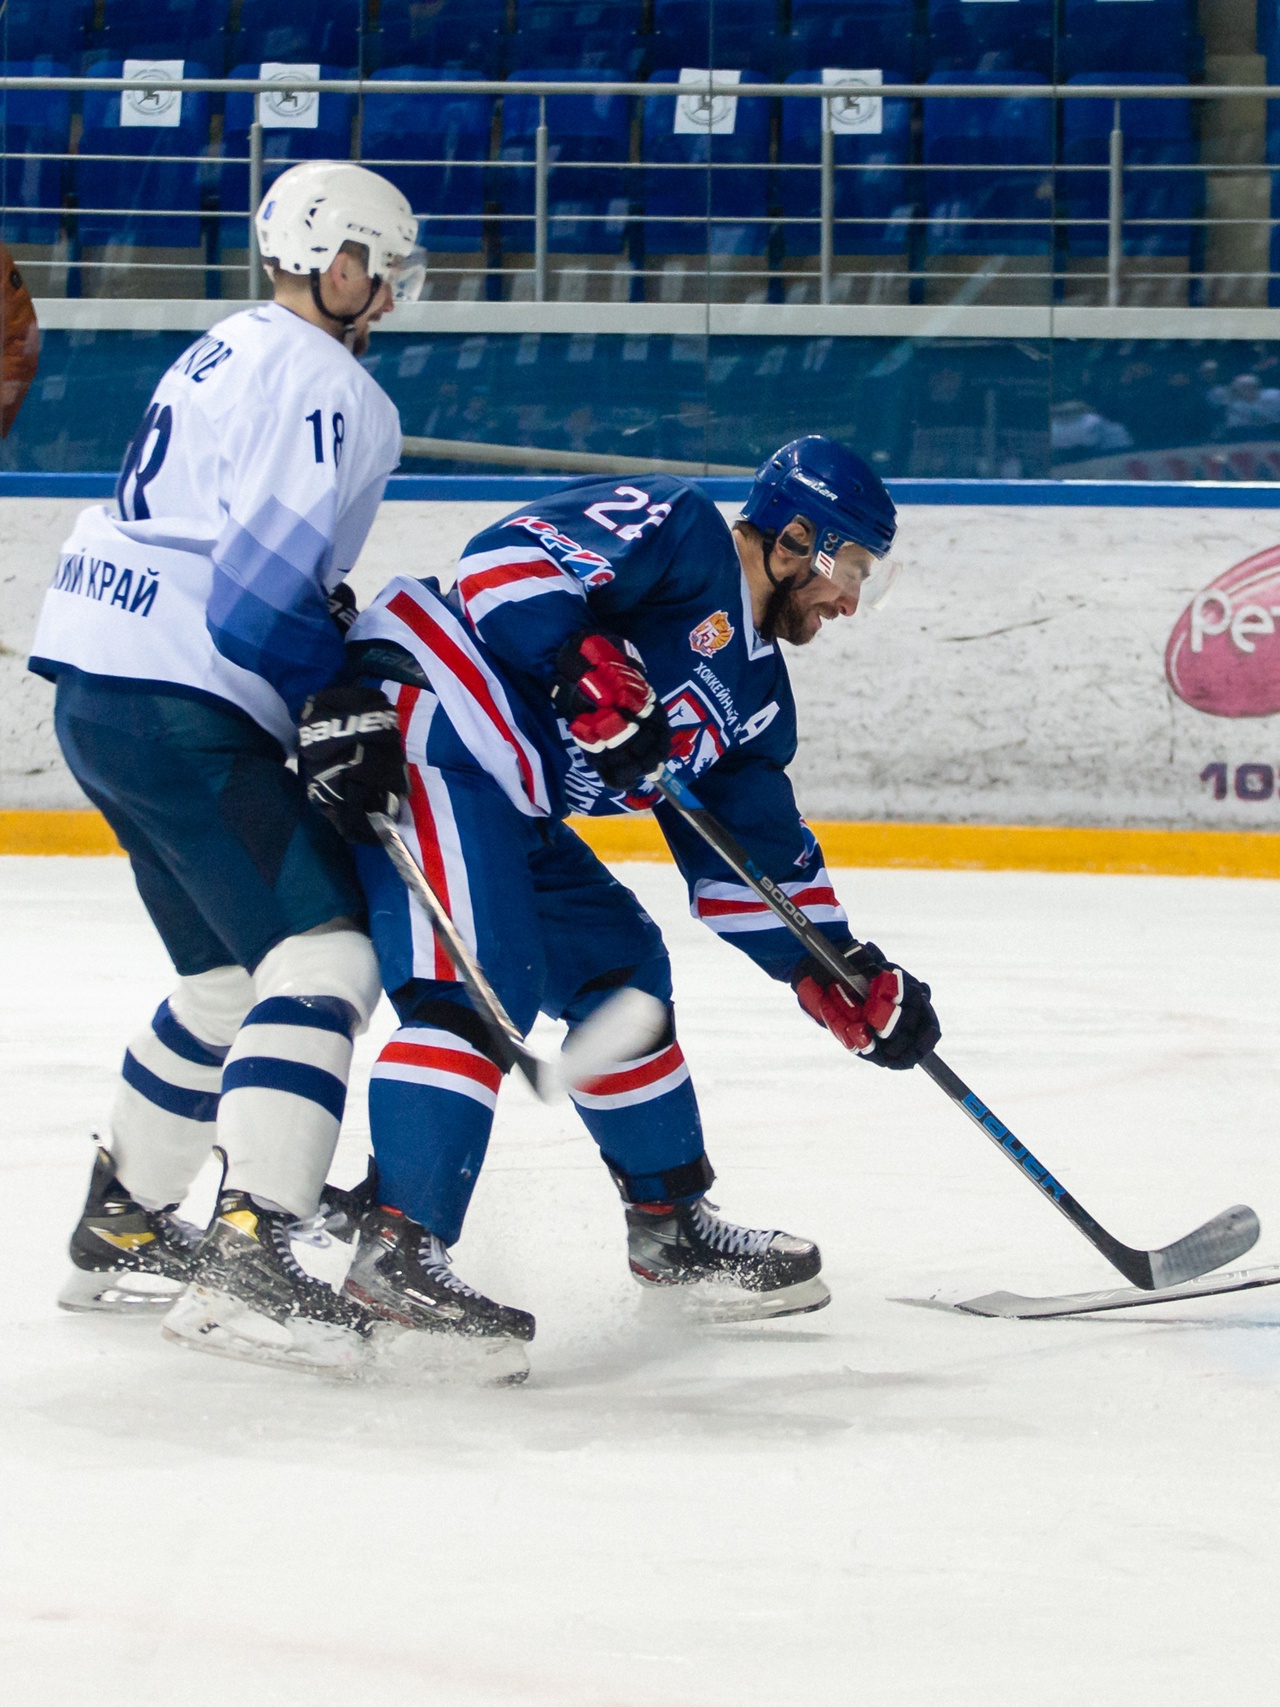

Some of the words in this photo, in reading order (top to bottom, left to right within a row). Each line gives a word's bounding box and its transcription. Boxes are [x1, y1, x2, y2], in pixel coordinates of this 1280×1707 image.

[305, 408, 345, 470] 18
[86, 557, 160, 618] КРАЙ
[692, 661, 740, 727] ХОККЕЙНЫЙ
